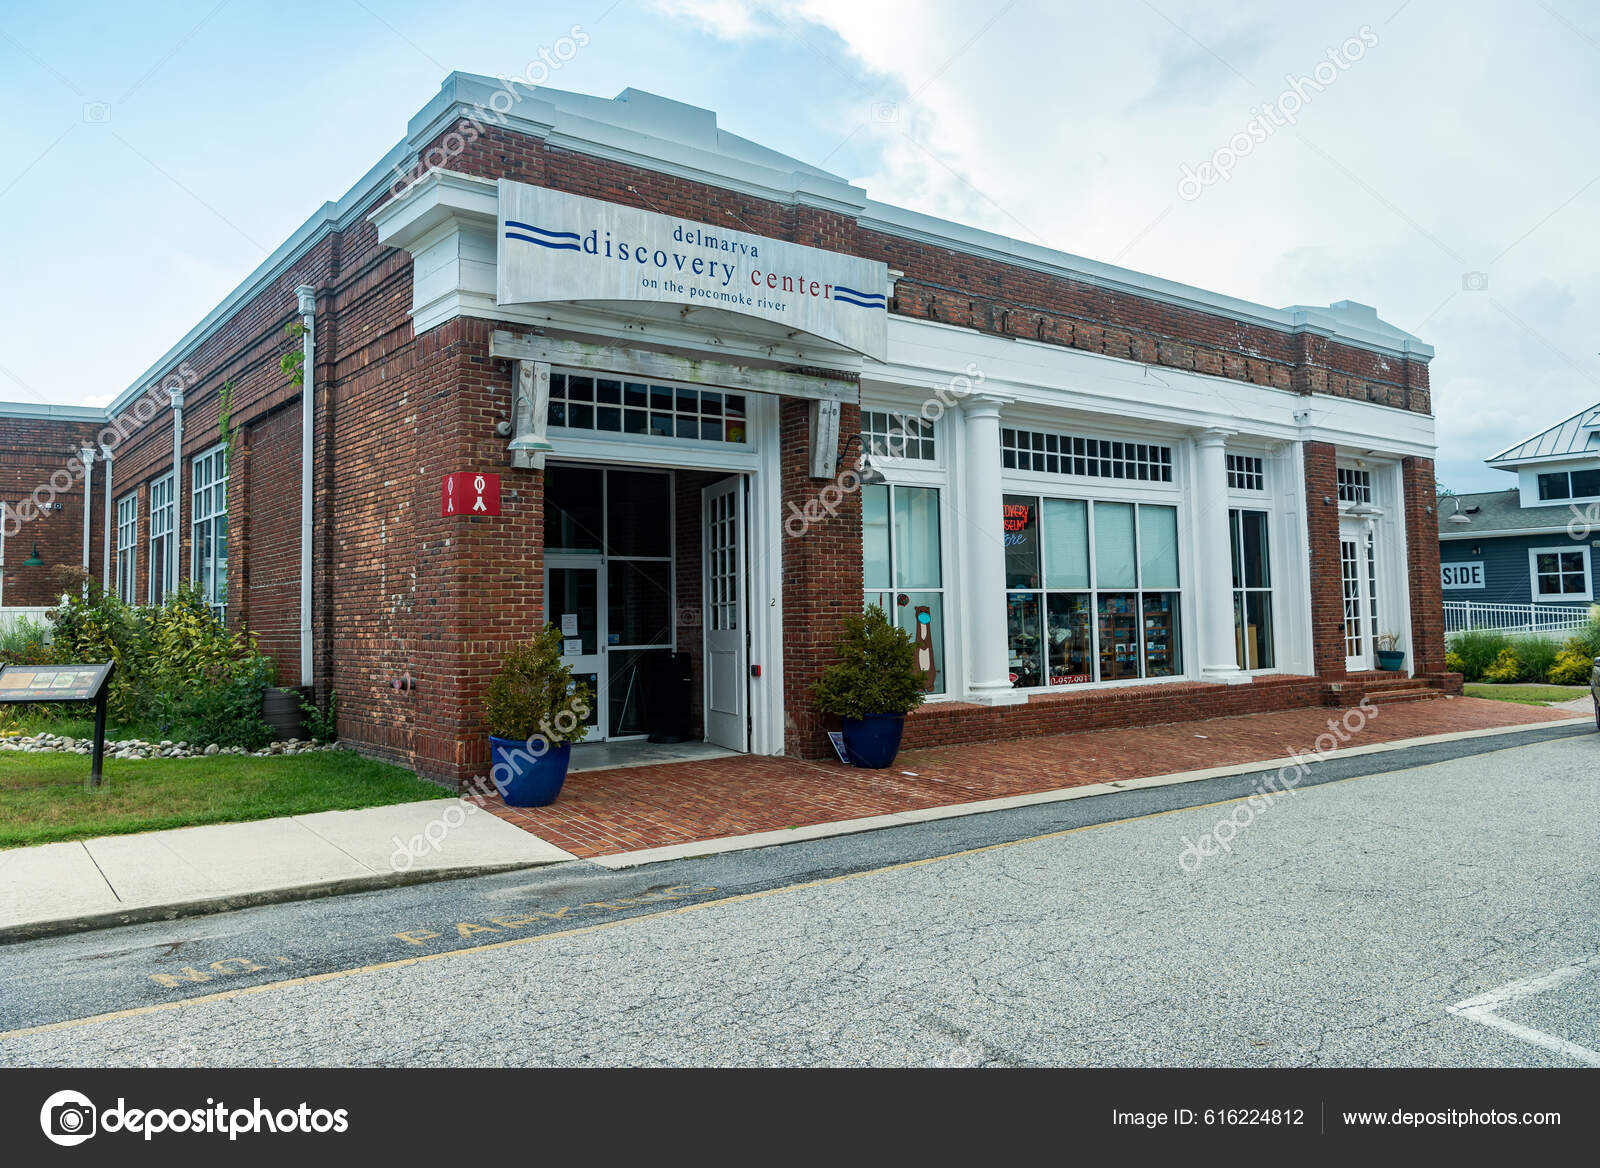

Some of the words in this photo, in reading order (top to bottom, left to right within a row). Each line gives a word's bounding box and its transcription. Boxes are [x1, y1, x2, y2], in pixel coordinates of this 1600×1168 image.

[673, 225, 759, 258] delmarva
[583, 229, 735, 286] discovery
[751, 269, 833, 300] center
[642, 278, 658, 289] on
[664, 280, 684, 293] the
[690, 286, 752, 305] pocomoke
[757, 297, 787, 312] river
[1003, 519, 1025, 531] SEUM
[770, 597, 776, 607] 2
